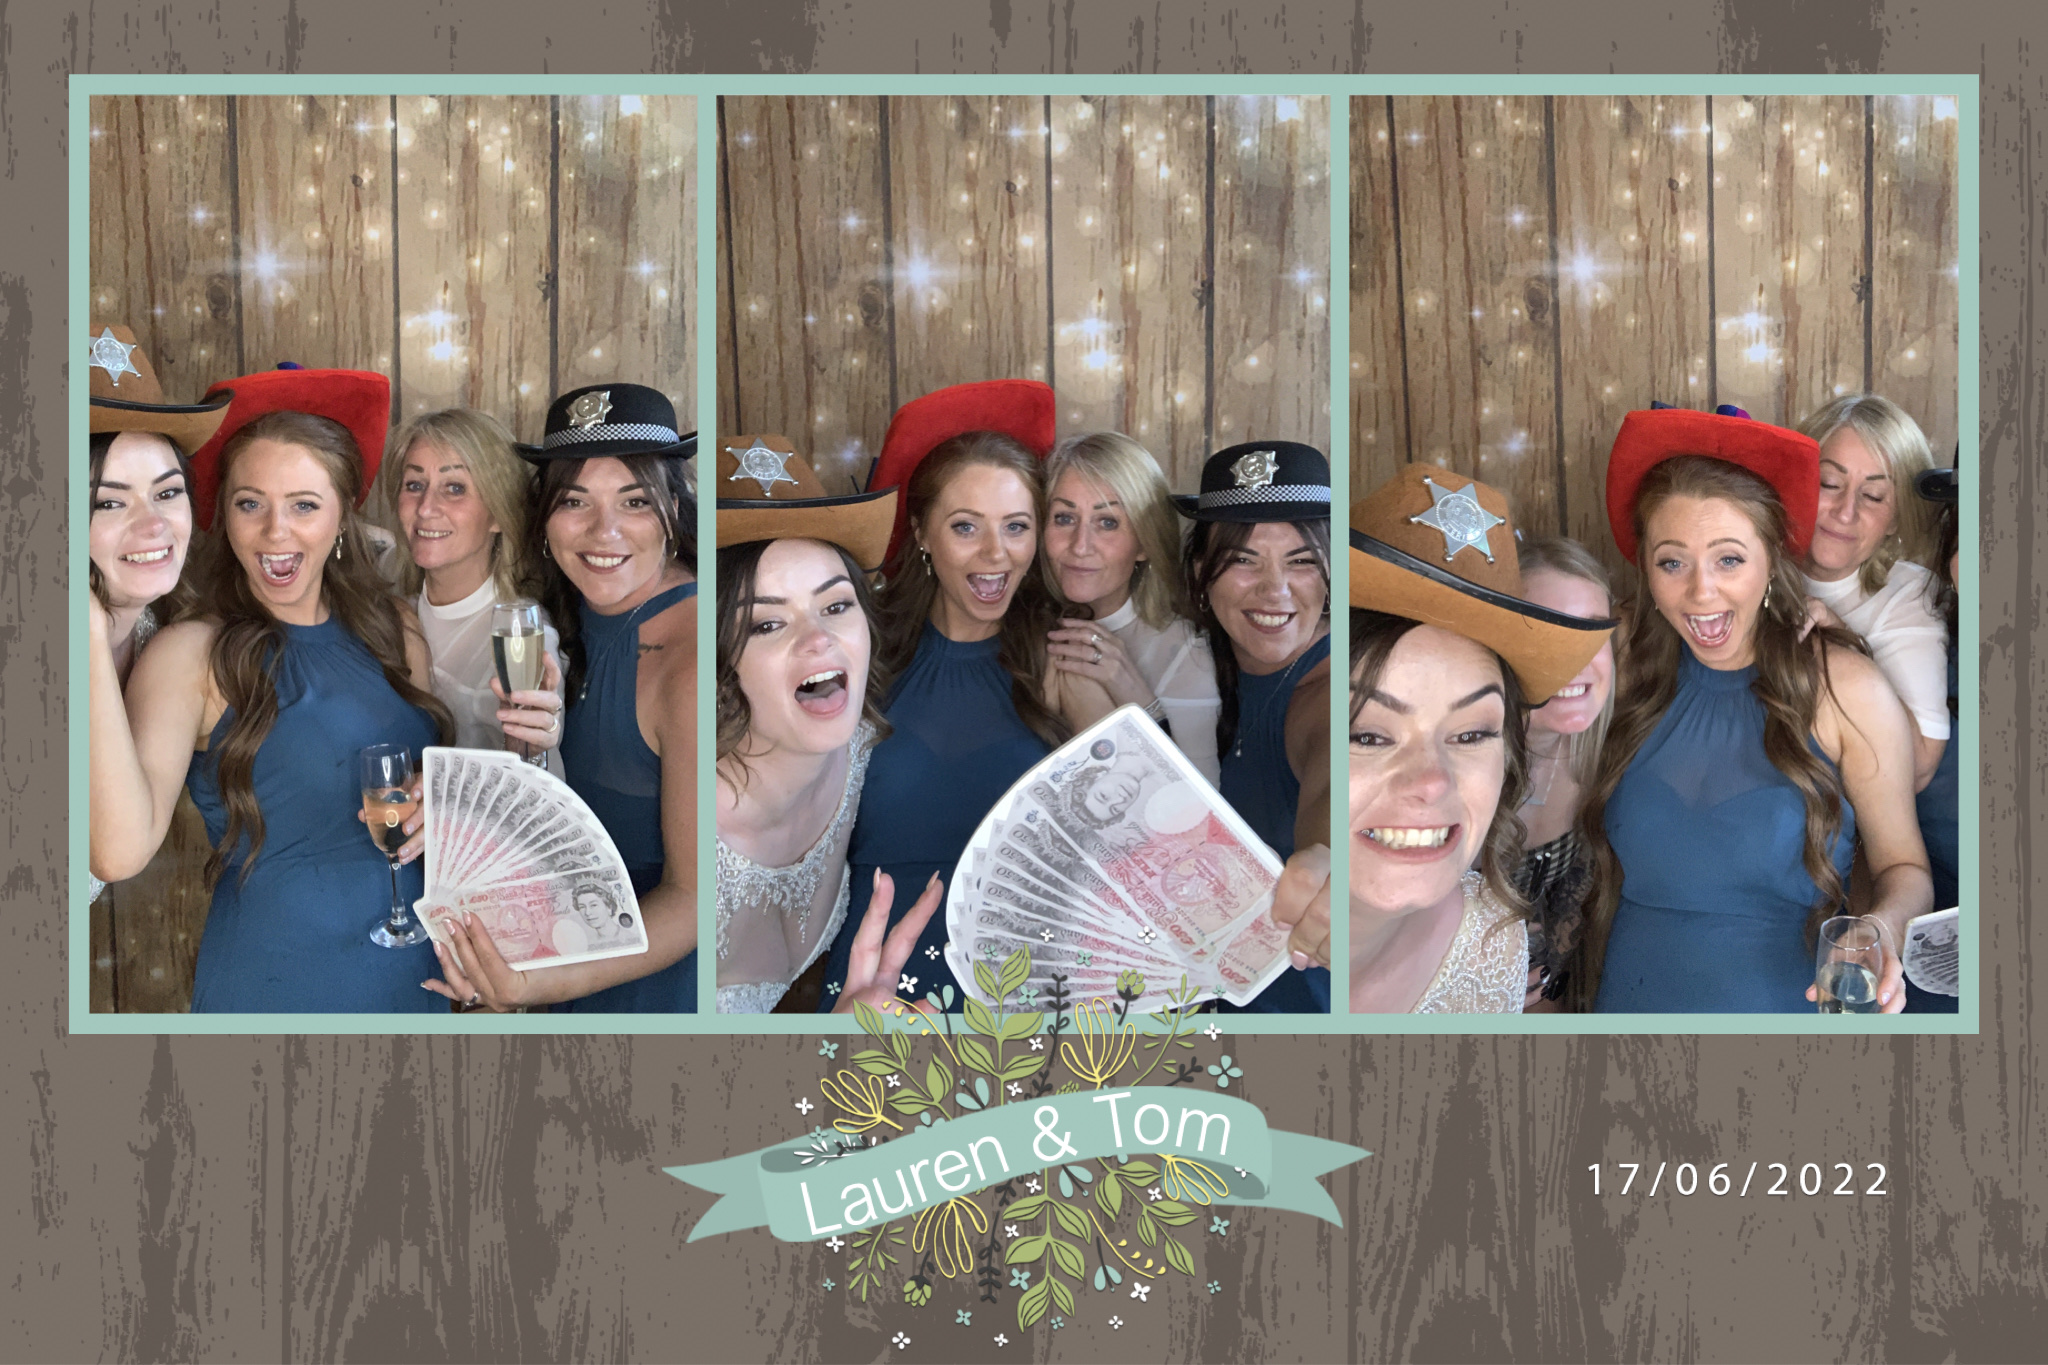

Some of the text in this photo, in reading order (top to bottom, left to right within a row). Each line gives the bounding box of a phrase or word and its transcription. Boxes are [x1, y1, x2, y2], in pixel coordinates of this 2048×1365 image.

[1118, 840, 1157, 879] FIFTY
[1131, 887, 1179, 933] Bank
[1168, 921, 1196, 949] £50
[1219, 964, 1251, 989] £50
